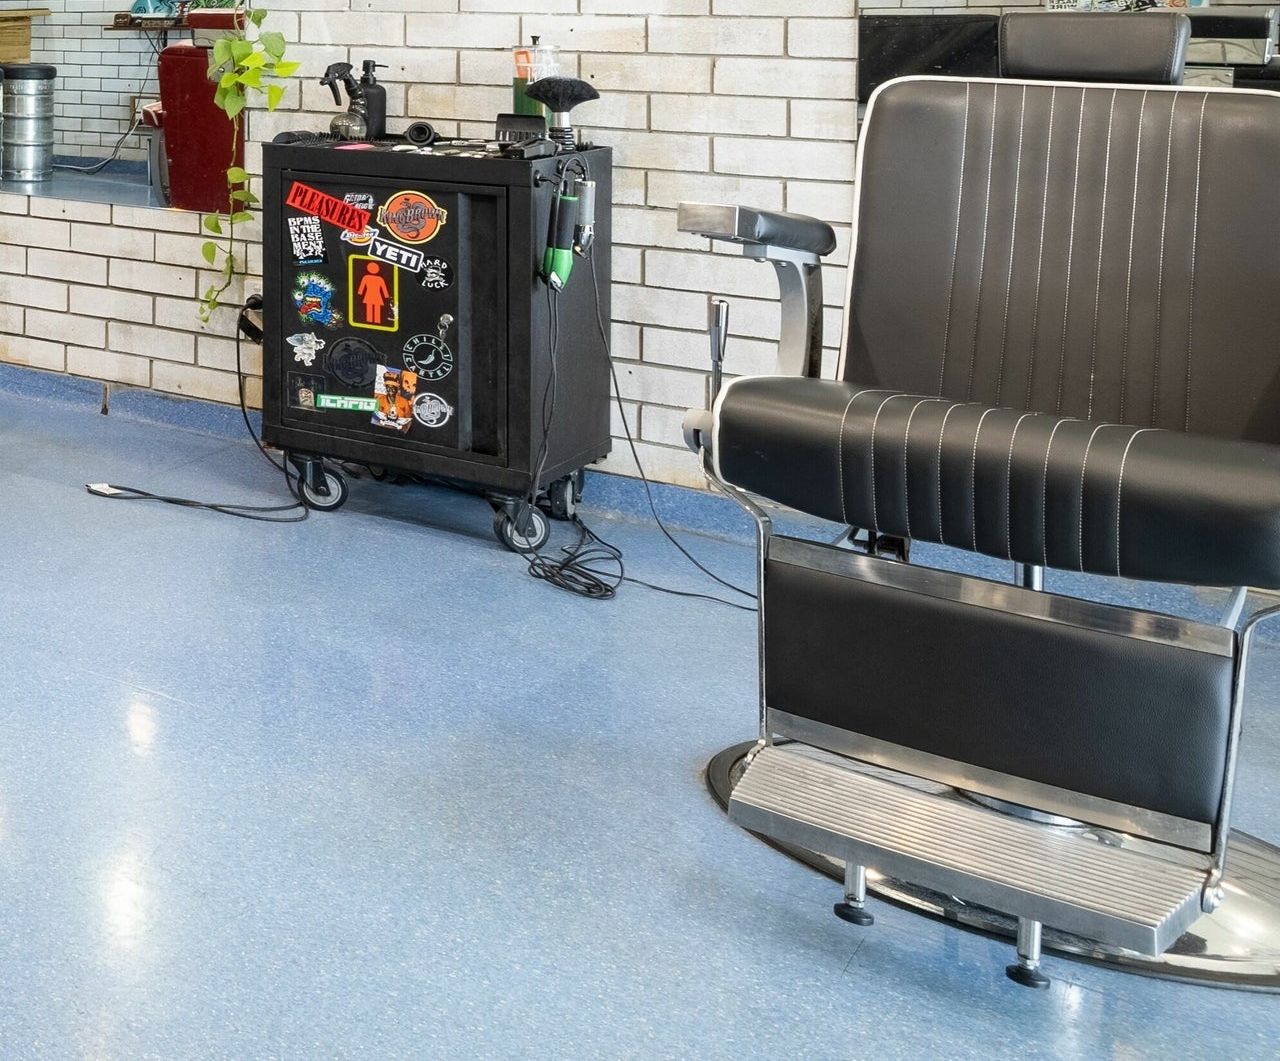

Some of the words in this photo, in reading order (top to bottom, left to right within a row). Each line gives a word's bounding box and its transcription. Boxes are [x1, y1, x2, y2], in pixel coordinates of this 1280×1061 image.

[291, 185, 367, 232] PLEASURES
[287, 216, 320, 226] BPMS
[300, 224, 322, 233] THE
[291, 233, 323, 243] BASE
[374, 241, 420, 268] YETI
[420, 259, 448, 269] HARD
[421, 279, 449, 289] LUCK
[406, 358, 450, 378] CARTEL
